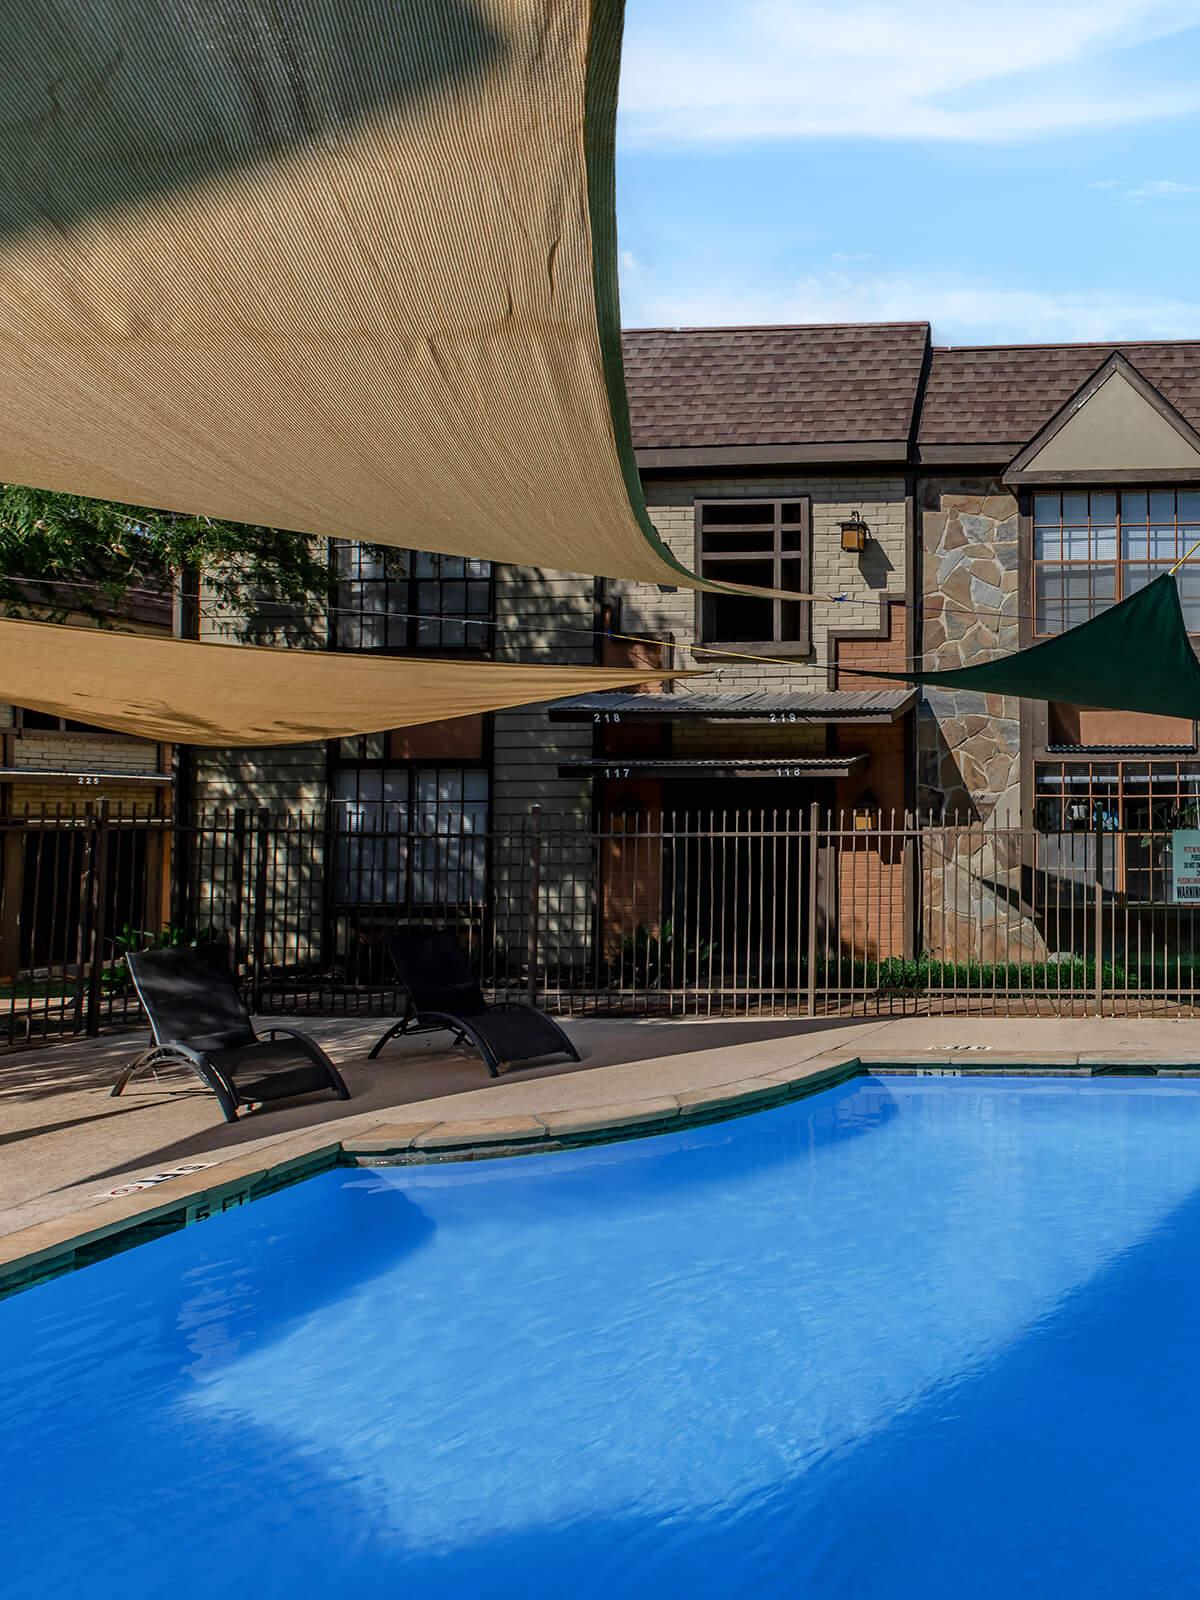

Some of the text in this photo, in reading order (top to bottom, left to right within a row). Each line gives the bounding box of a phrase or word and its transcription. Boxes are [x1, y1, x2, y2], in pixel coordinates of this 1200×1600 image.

[593, 713, 620, 723] 218
[770, 713, 796, 723] 219
[604, 768, 630, 778] 117
[777, 767, 801, 777] 118
[195, 1190, 248, 1222] 5 FT
